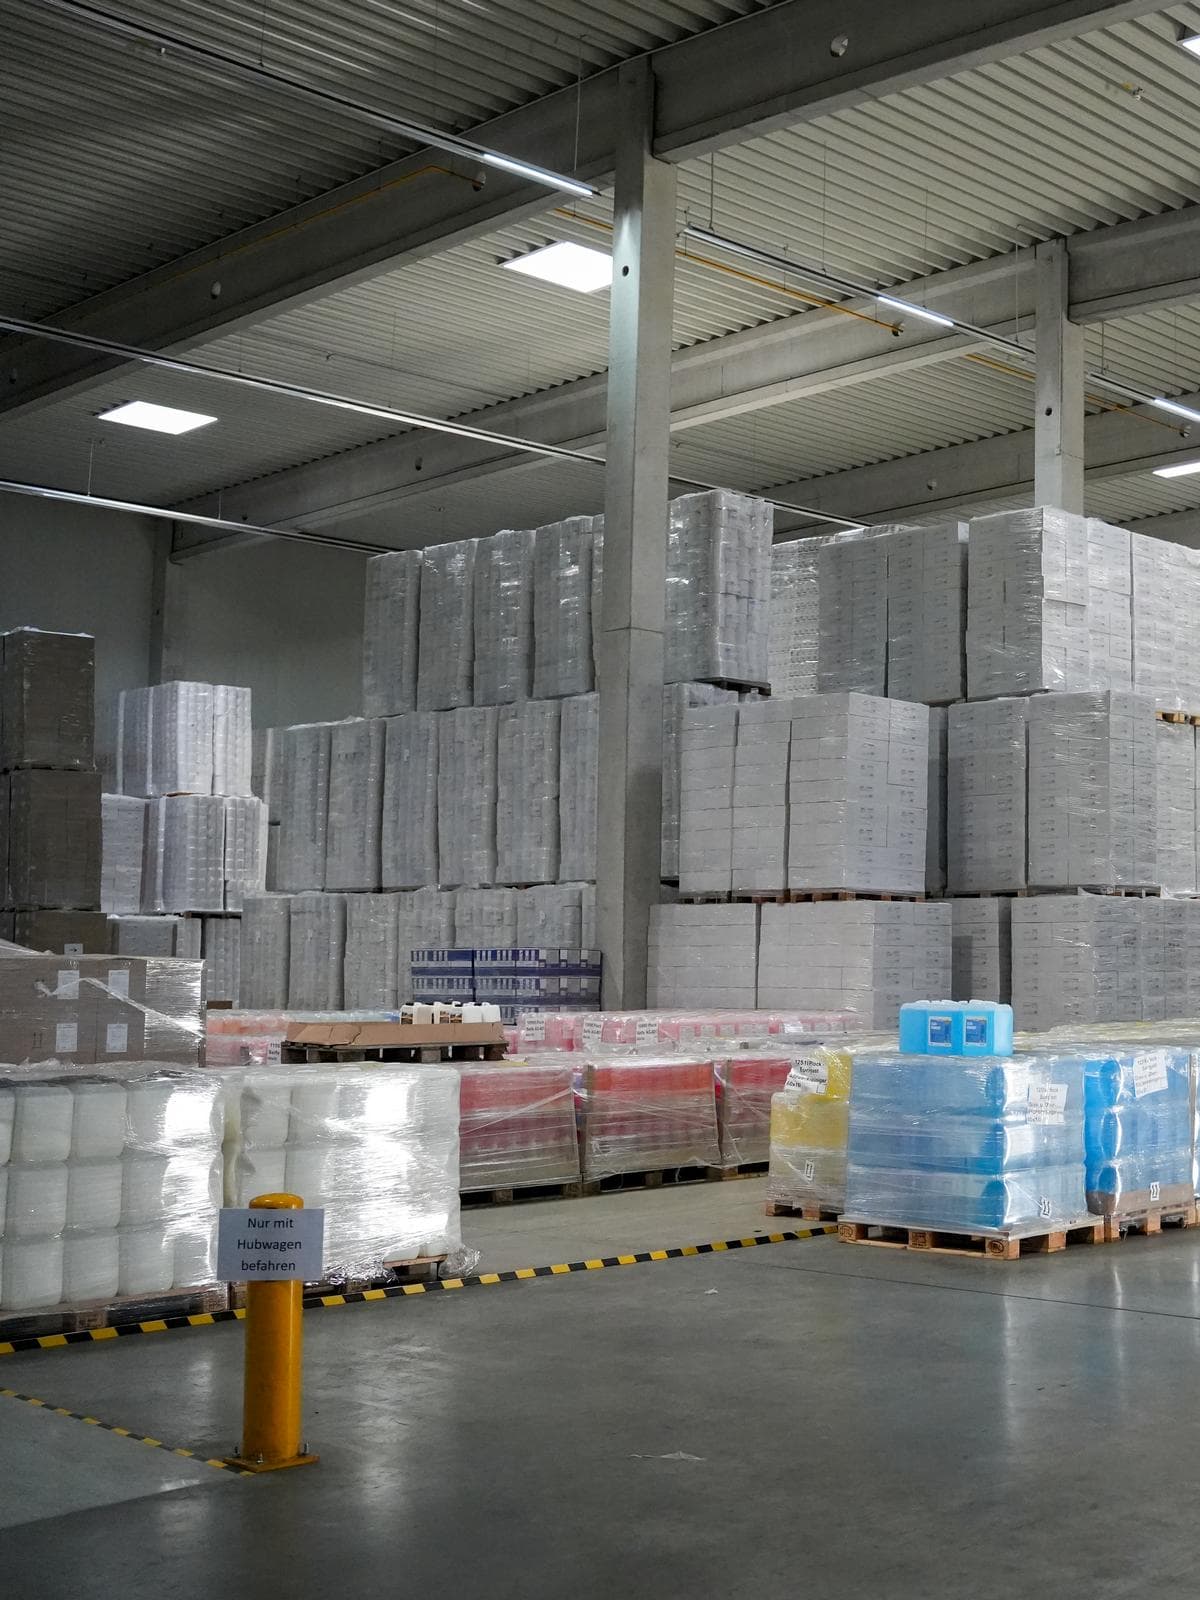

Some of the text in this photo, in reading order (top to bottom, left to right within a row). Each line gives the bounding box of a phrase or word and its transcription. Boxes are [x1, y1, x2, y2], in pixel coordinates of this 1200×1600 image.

[247, 1217, 294, 1228] Nur mit
[237, 1238, 302, 1252] Hubwagen
[241, 1259, 296, 1271] befahren
